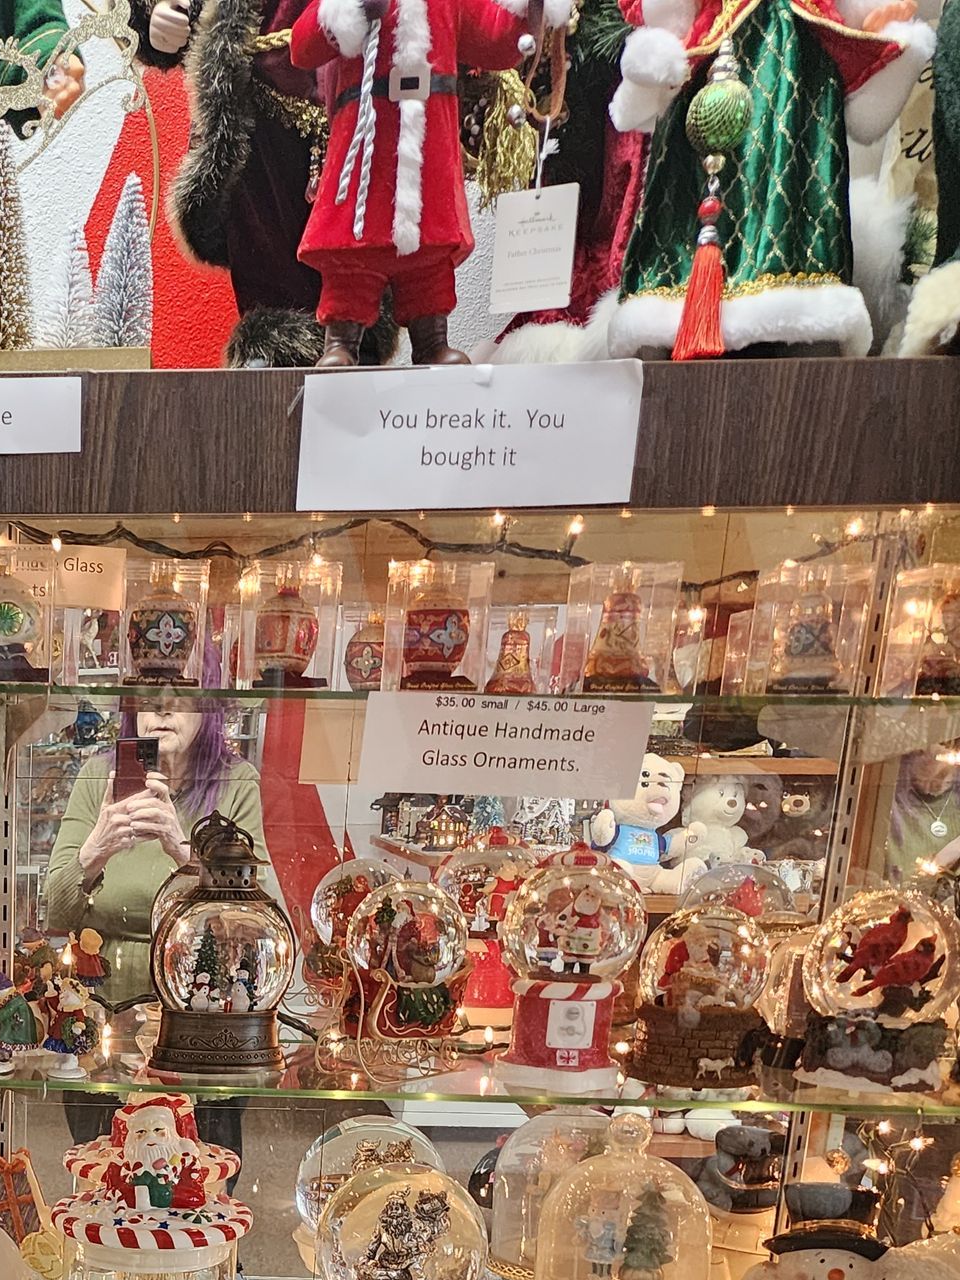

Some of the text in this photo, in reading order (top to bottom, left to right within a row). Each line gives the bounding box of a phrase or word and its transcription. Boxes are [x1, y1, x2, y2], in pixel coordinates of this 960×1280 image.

[379, 408, 565, 429] You break it. You
[420, 446, 517, 471] bought it
[64, 556, 104, 574] Glass
[435, 696, 476, 708] $35.00
[481, 698, 509, 709] small
[527, 700, 568, 712] $45.00
[573, 702, 606, 715] Large
[417, 719, 595, 743] Antique Handmade
[422, 749, 580, 772] Glass Ornaments.
